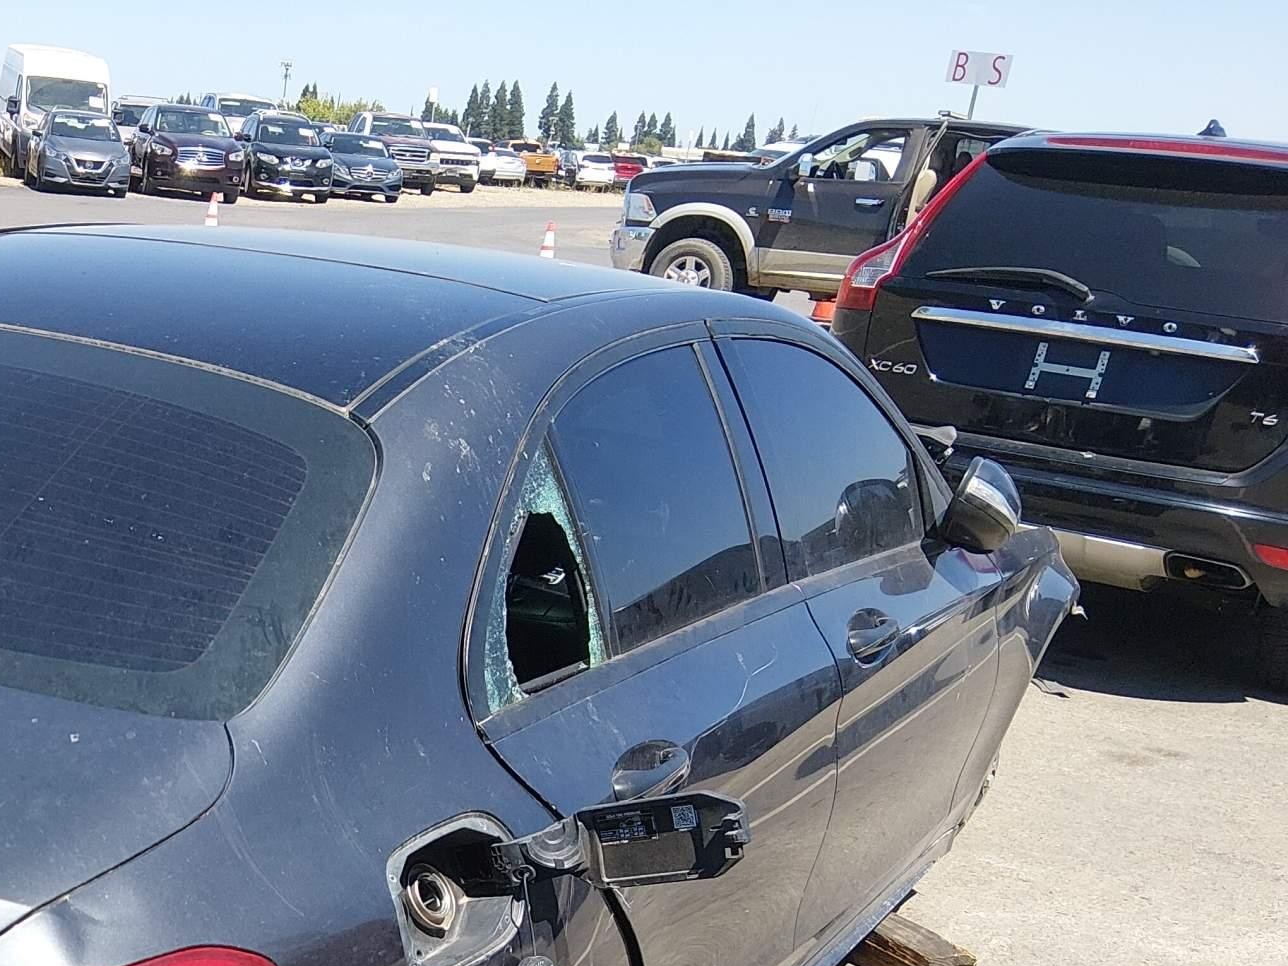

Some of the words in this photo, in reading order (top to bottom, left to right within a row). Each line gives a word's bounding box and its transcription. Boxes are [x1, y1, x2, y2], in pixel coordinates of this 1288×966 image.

[952, 52, 969, 82] B
[987, 55, 1006, 85] S
[988, 298, 1178, 334] VOLVO
[868, 358, 918, 375] XC60
[1250, 411, 1279, 426] T6
